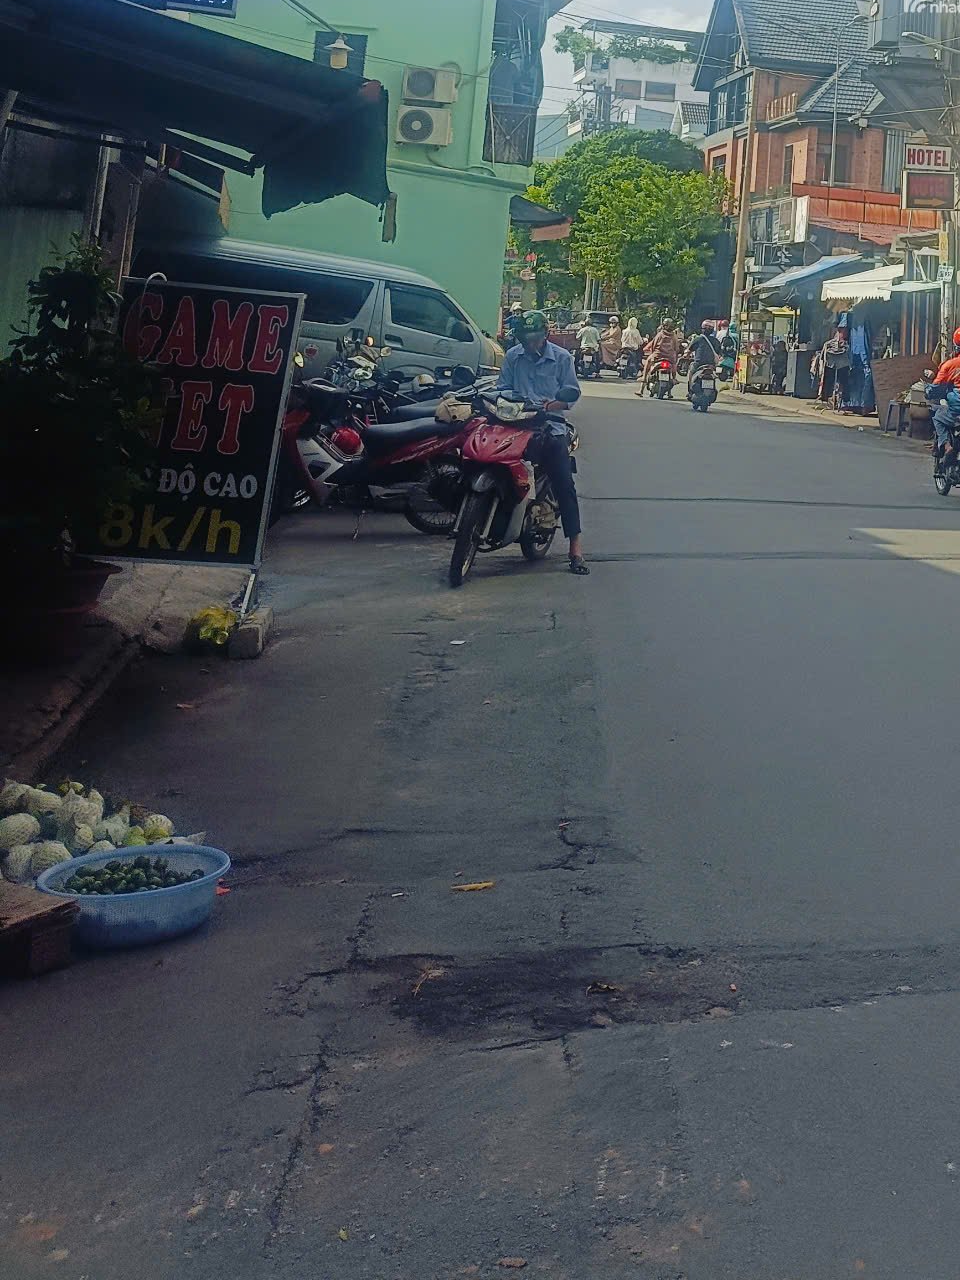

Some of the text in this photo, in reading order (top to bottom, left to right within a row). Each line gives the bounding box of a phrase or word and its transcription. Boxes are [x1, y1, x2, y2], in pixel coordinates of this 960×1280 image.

[907, 148, 949, 167] HOTEL
[122, 291, 289, 375] GAME
[157, 463, 258, 502] ĐỘ CAO
[102, 502, 242, 554] 8k/h
